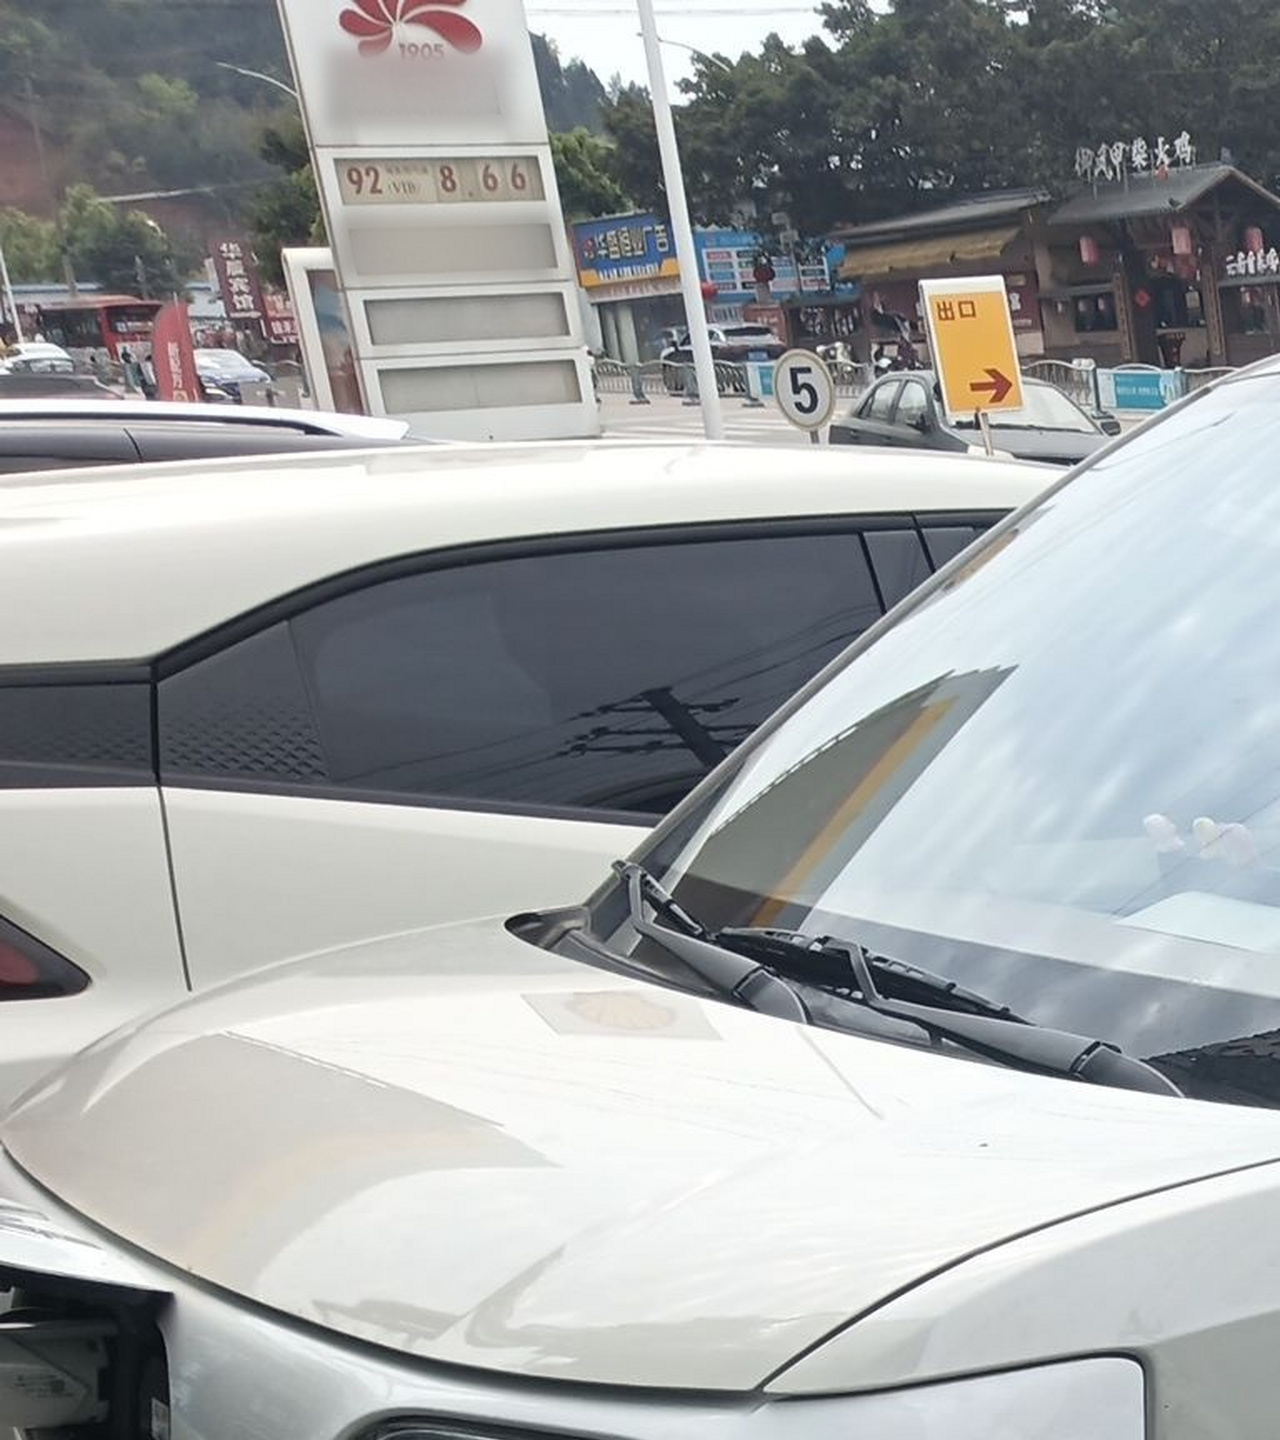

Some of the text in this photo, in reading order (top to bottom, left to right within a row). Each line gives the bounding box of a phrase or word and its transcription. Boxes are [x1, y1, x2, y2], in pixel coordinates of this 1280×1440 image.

[347, 166, 383, 194] 92
[937, 300, 976, 321] 出口
[789, 366, 818, 414] 5
